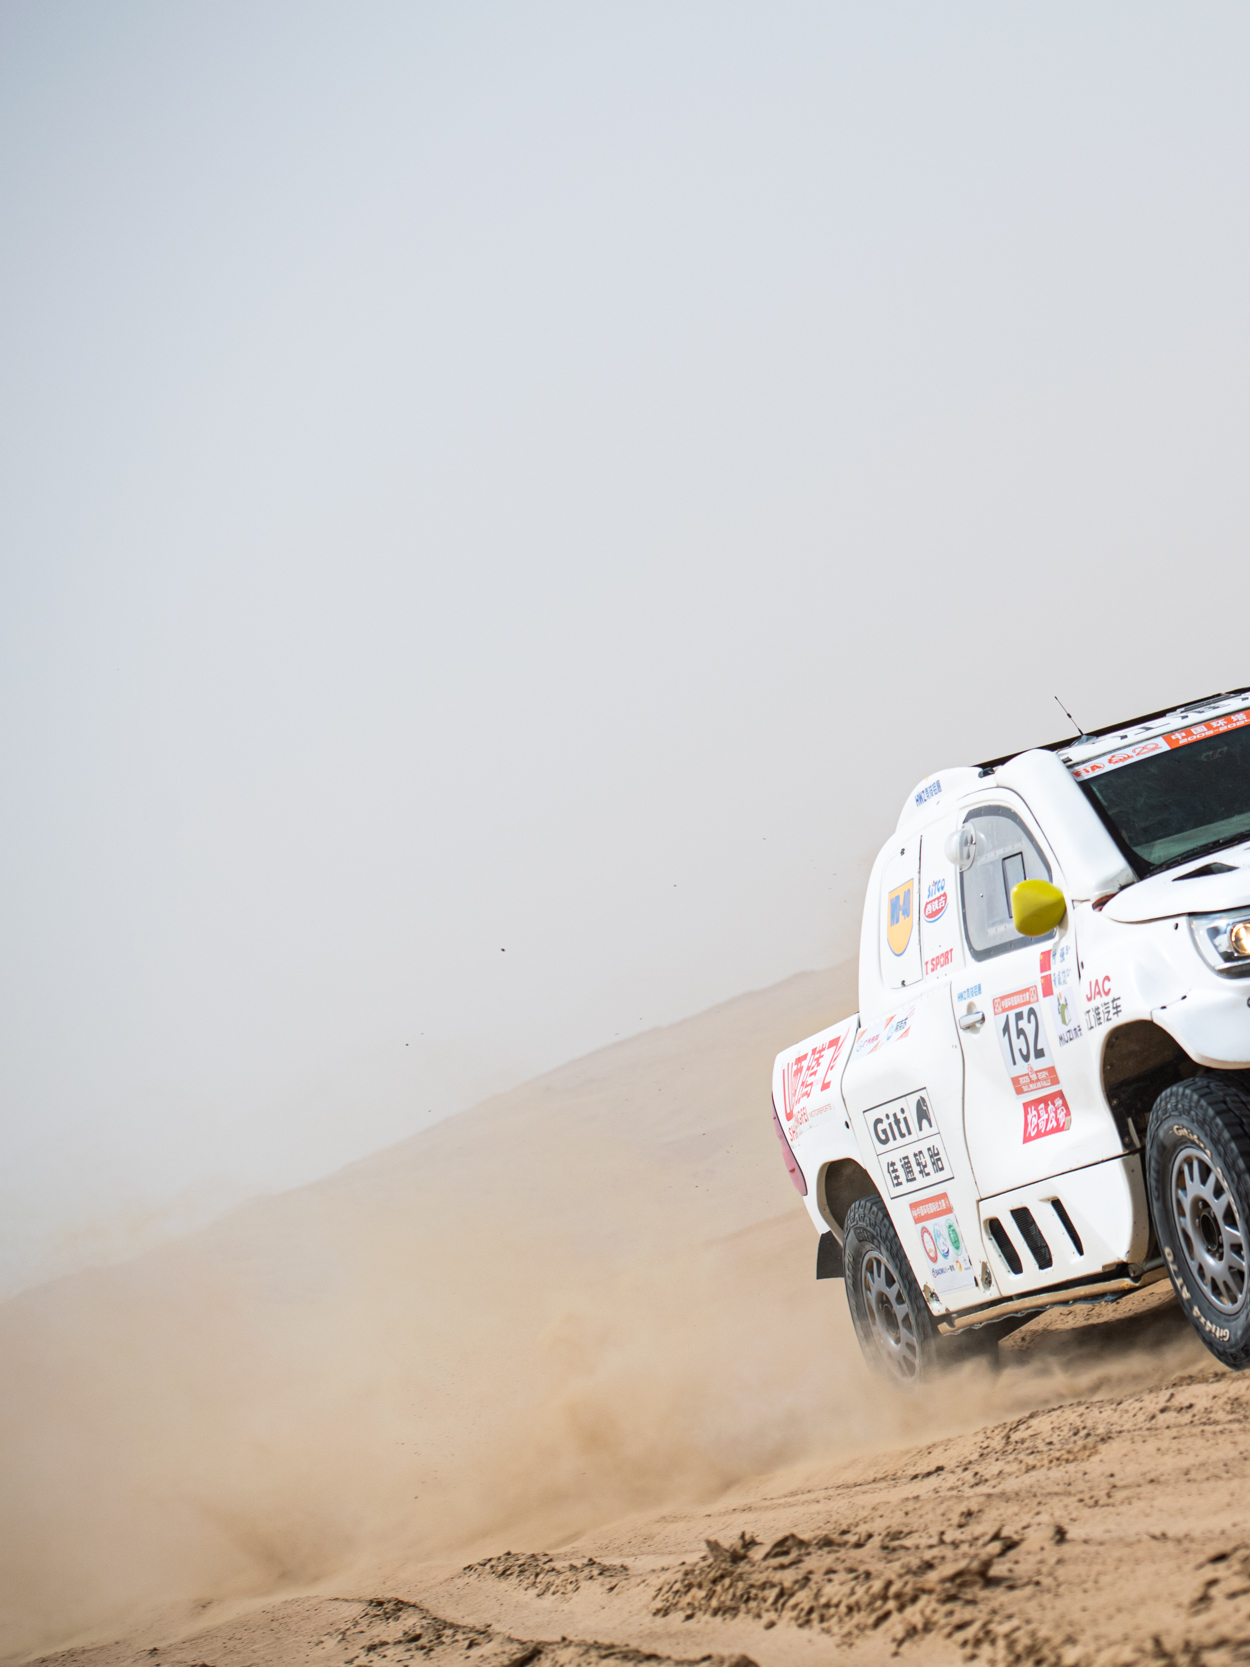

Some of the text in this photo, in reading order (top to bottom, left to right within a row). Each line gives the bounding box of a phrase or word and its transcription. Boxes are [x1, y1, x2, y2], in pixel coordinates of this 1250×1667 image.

[890, 887, 911, 927] WD-40
[930, 948, 953, 973] SPORT
[1086, 975, 1112, 1002] JAC
[1084, 996, 1122, 1031] 江淮汽车
[1002, 1007, 1046, 1066] 152
[873, 1107, 912, 1146] Giti
[886, 1144, 945, 1188] 佳通轮胎
